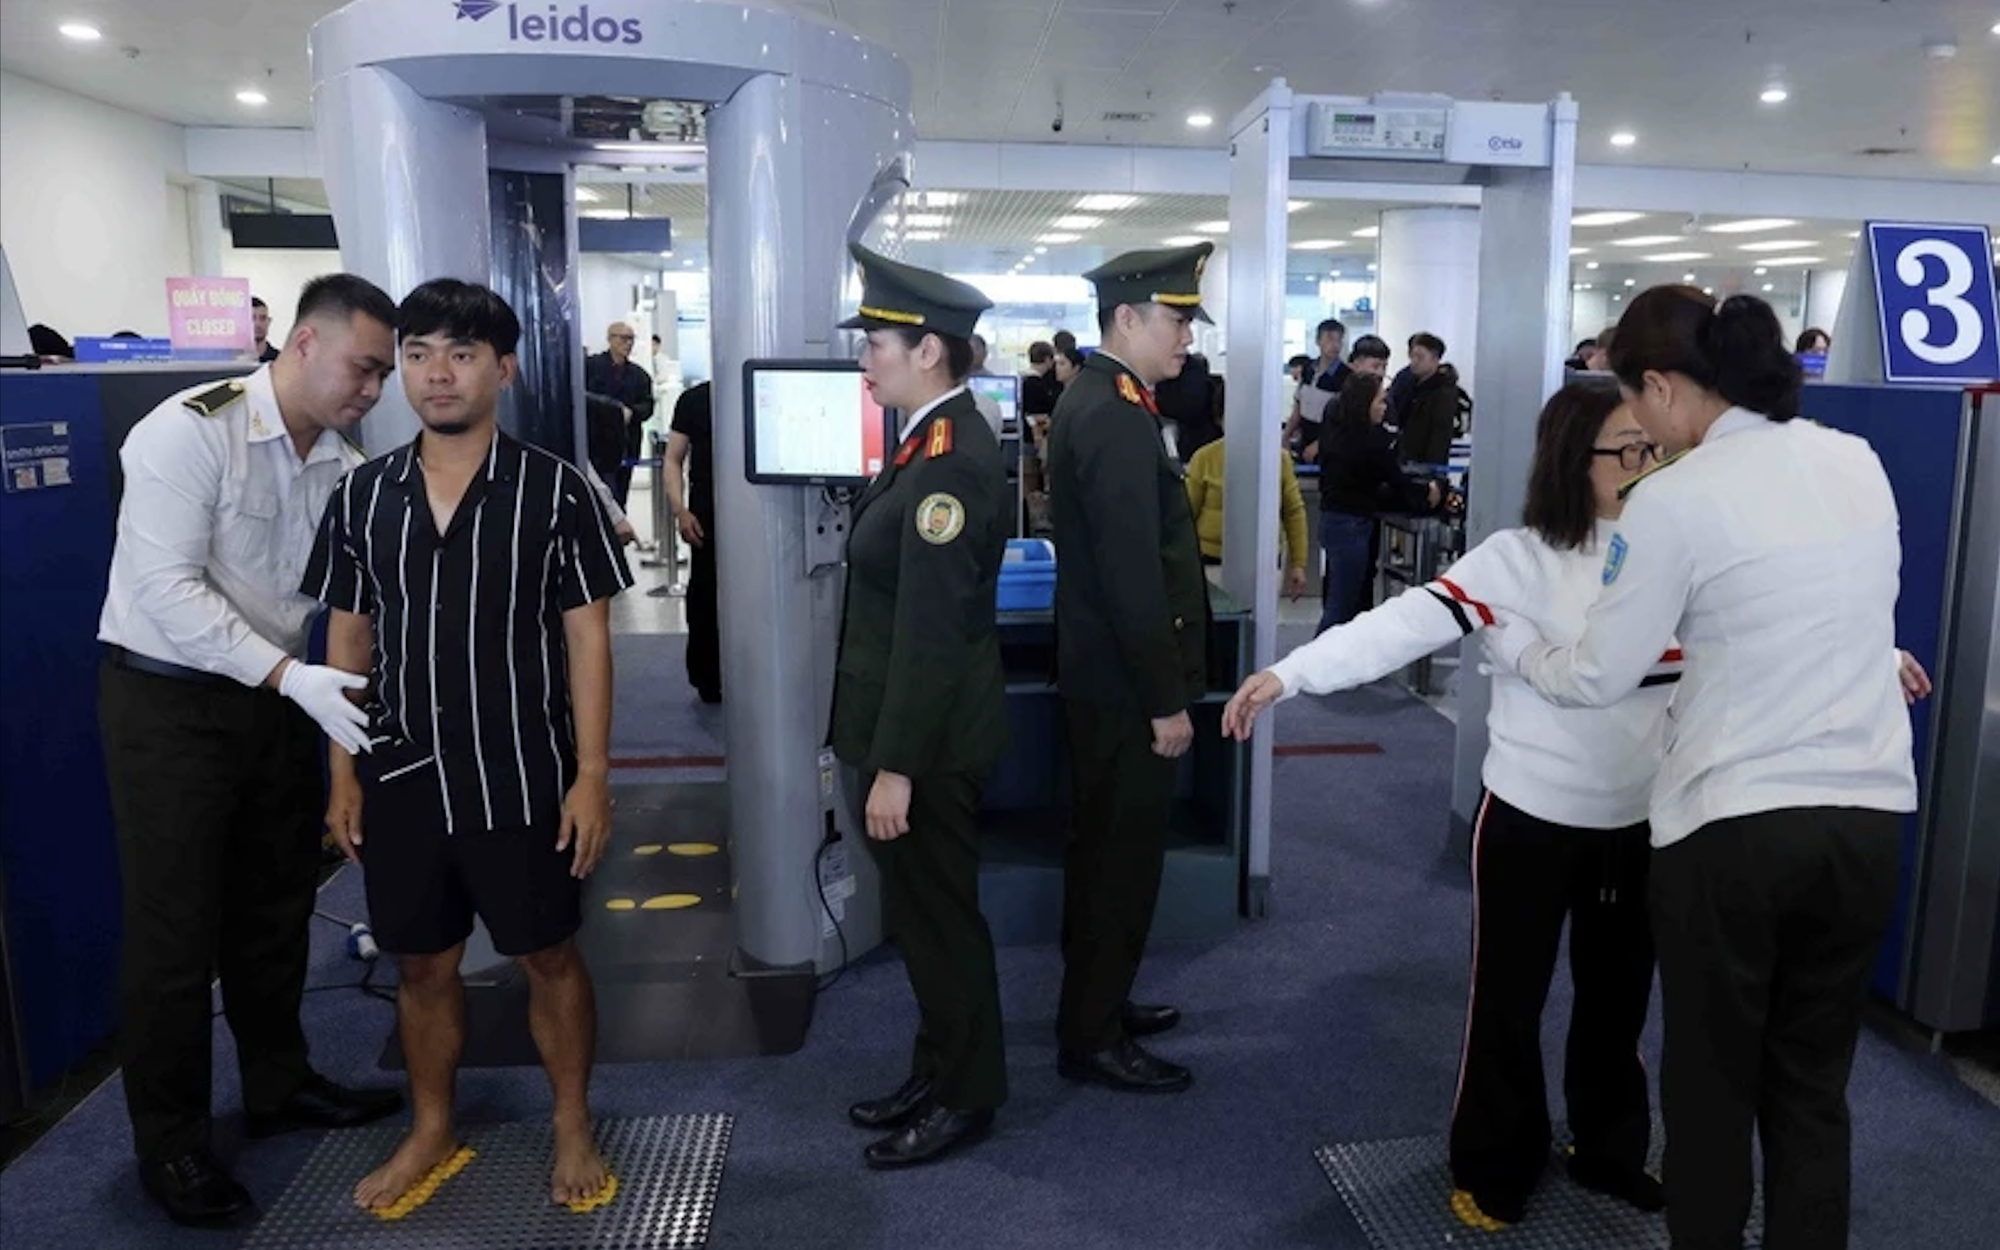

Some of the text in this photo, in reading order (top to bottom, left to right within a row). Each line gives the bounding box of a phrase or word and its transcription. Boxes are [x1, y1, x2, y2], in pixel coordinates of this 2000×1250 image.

[508, 3, 643, 45] leidos
[1896, 238, 1984, 365] 3
[186, 318, 237, 337] CLOSED
